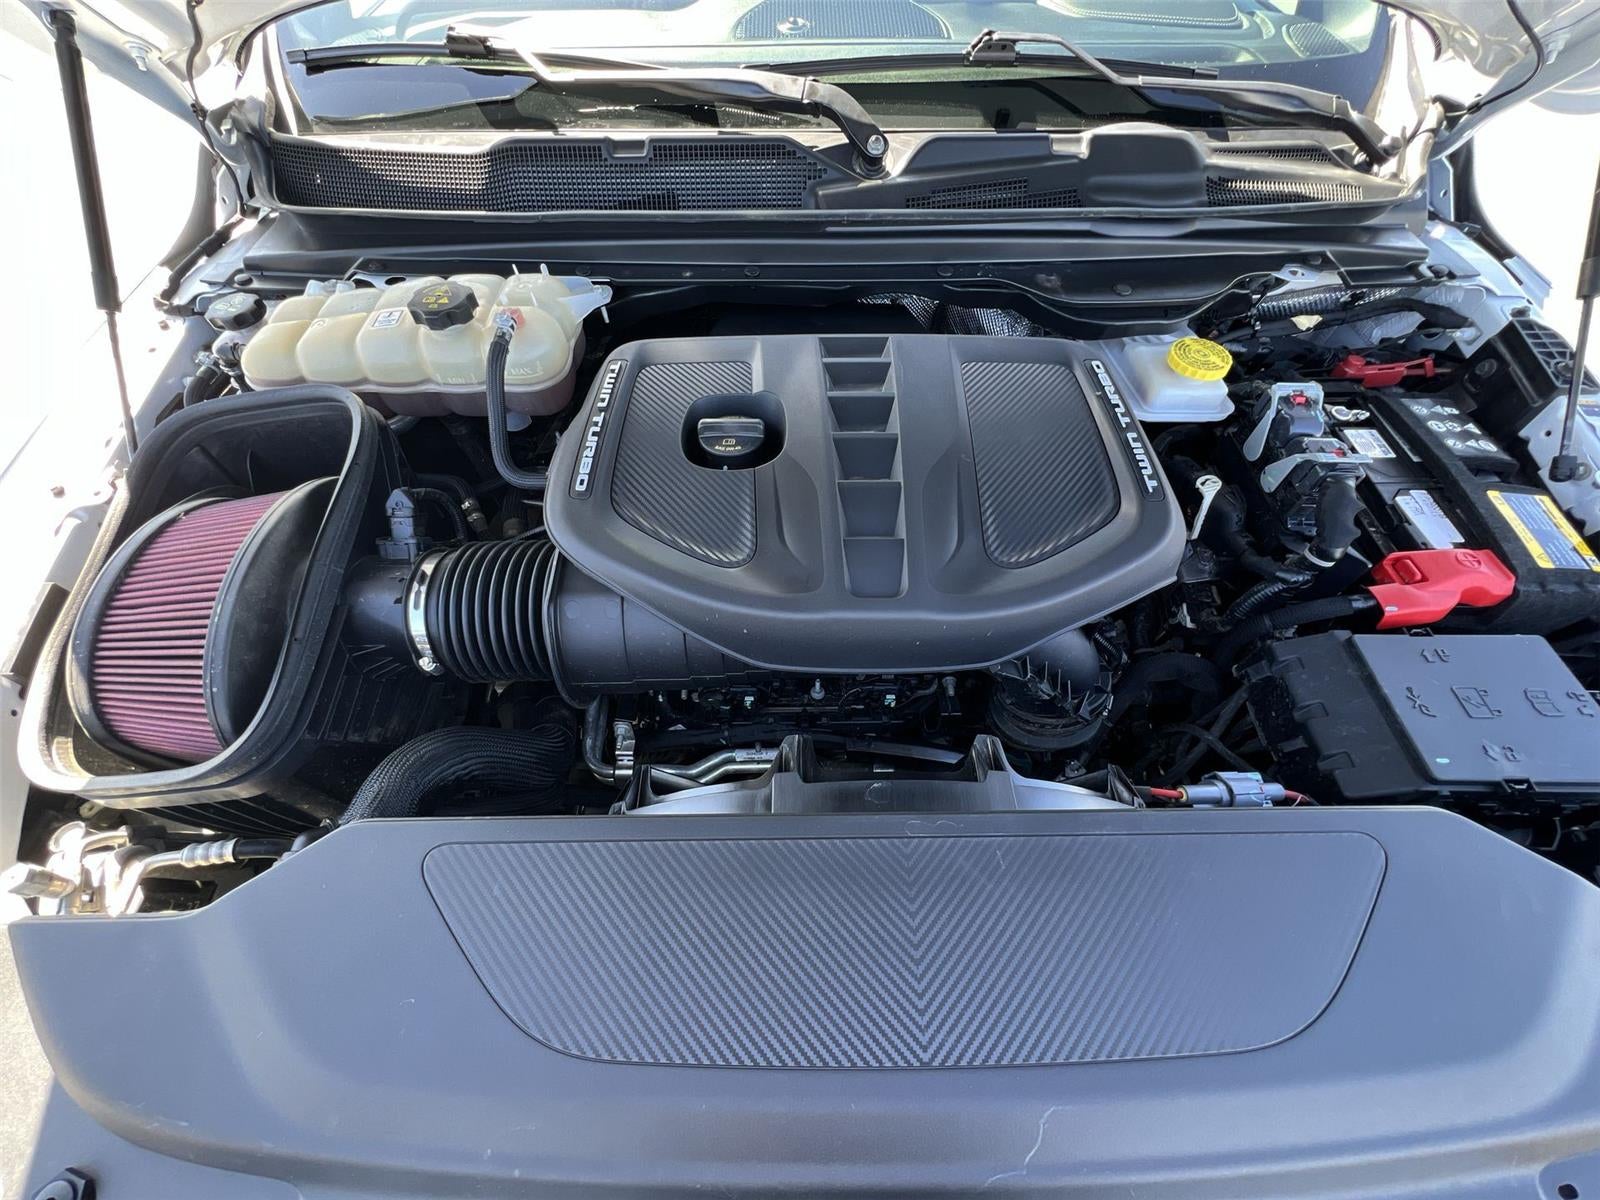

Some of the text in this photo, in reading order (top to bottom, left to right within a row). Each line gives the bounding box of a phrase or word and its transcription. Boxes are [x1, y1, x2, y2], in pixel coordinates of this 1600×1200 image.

[575, 361, 621, 491] TWIN TURBO
[1091, 360, 1159, 493] TWIN TURBO
